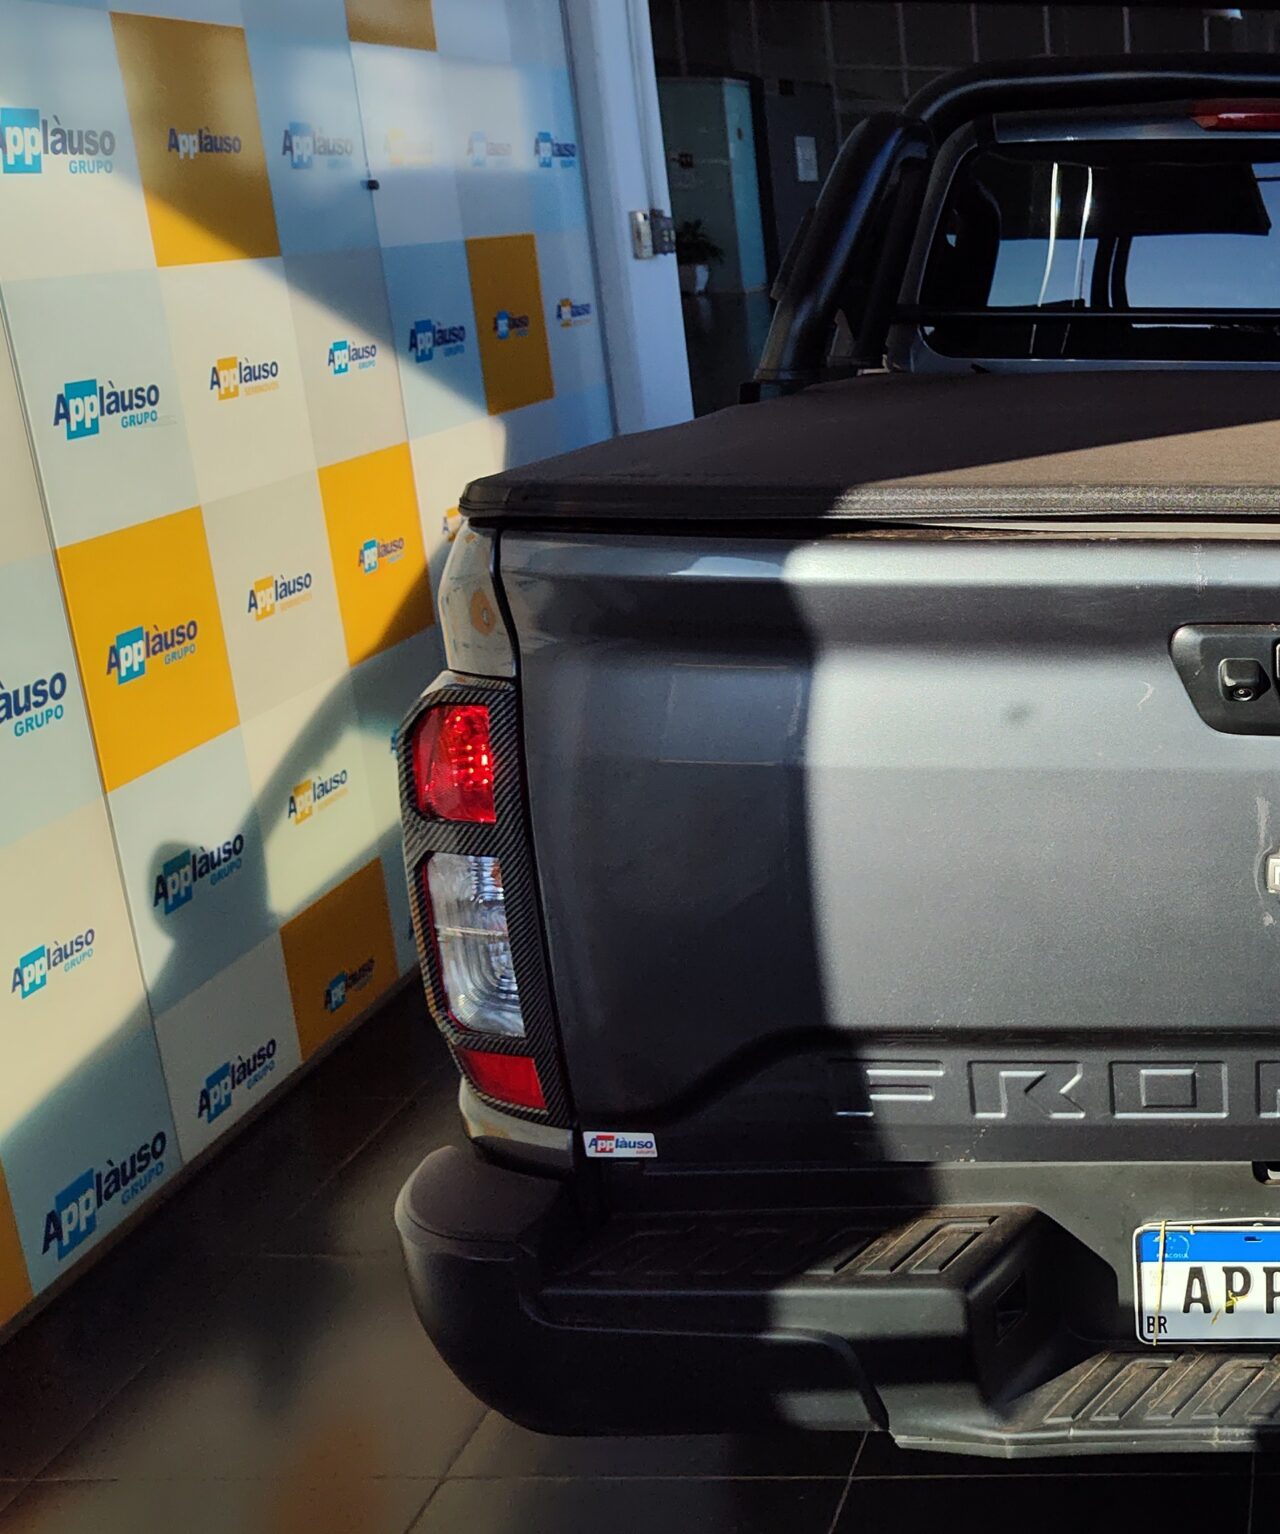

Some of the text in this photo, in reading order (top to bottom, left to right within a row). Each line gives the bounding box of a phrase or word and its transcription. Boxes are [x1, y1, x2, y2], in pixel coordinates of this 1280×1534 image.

[168, 127, 242, 160] Applàuso
[69, 160, 113, 174] GRUPO
[328, 342, 377, 370] Applàuso
[210, 357, 279, 395] Applàuso
[53, 380, 160, 432] Applàuso
[121, 410, 158, 428] GRUPO
[248, 572, 312, 615] Applàuso
[106, 620, 198, 677] Applàuso
[164, 644, 196, 664] GRUPO
[14, 704, 64, 736] GRUPO
[153, 833, 245, 907] Applàuso
[11, 928, 95, 993] Applàuso
[64, 948, 93, 972] GRUPO
[198, 1038, 276, 1119] Applàuso
[42, 1131, 167, 1256] Applàuso
[121, 1161, 164, 1205] GRUPO
[1146, 1315, 1168, 1334] BR
